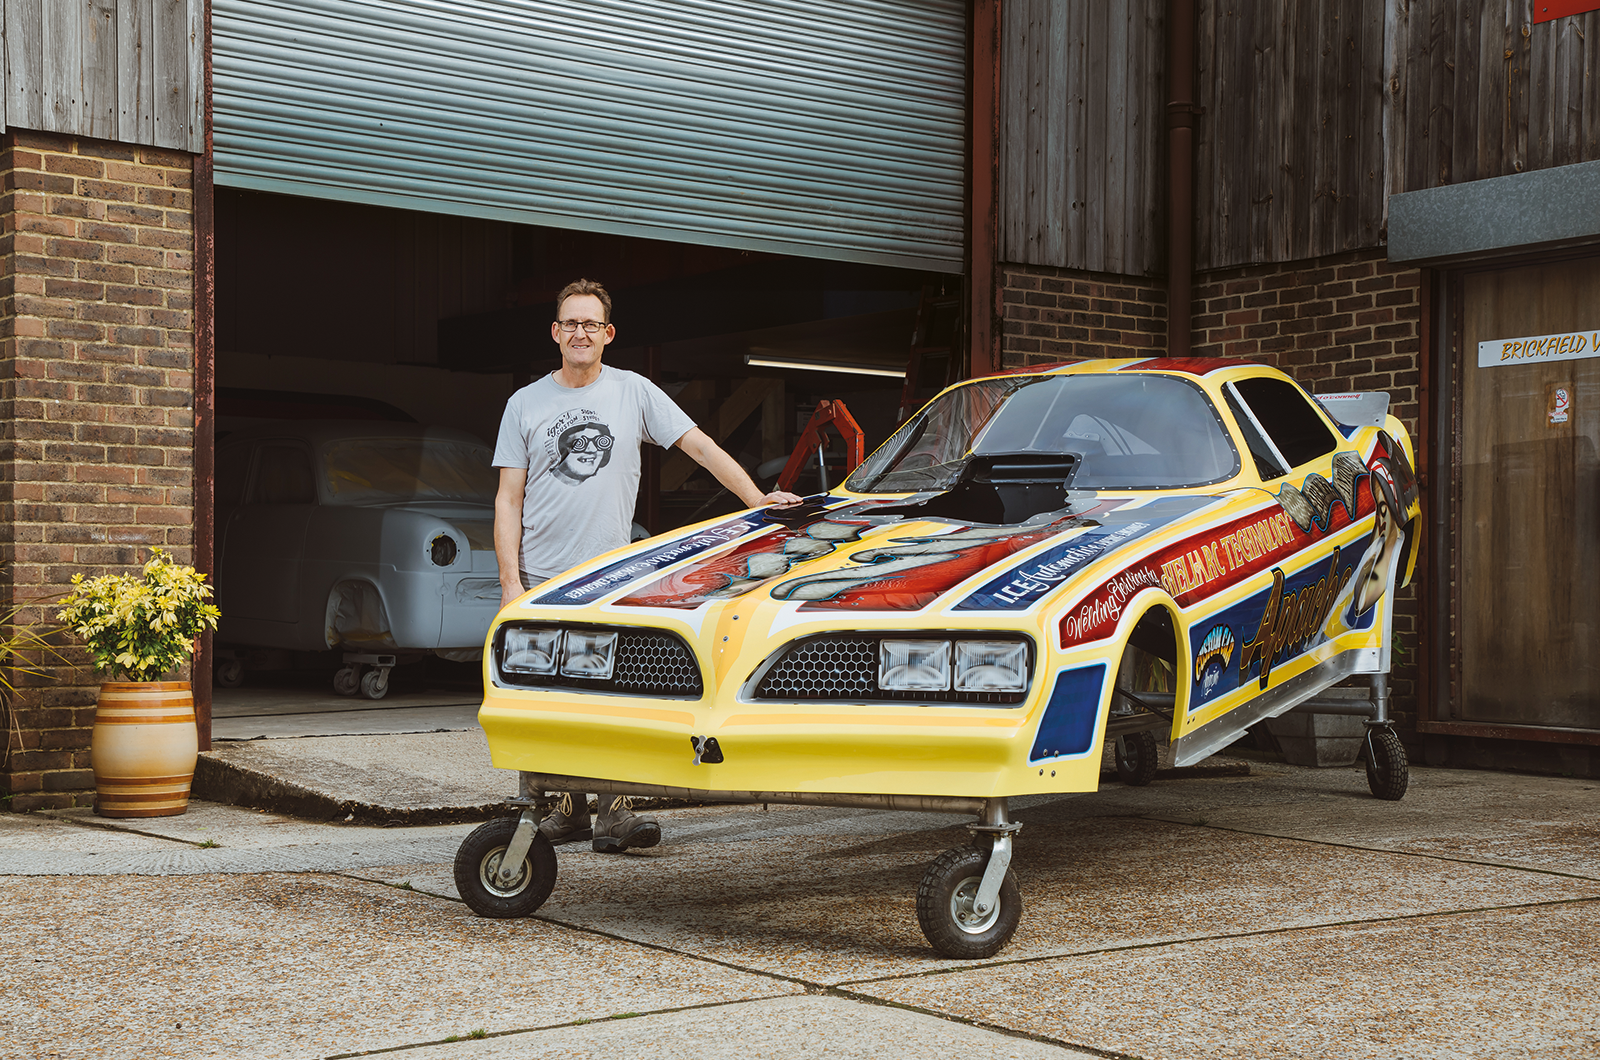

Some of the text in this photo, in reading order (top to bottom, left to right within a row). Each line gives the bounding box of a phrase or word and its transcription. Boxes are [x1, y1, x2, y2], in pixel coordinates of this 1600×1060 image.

[1500, 334, 1587, 361] BRICKFIELD
[556, 416, 578, 435] CUSTOM
[1161, 510, 1295, 598] HELIARC TECHNOLOGY
[1066, 595, 1122, 640] Welding
